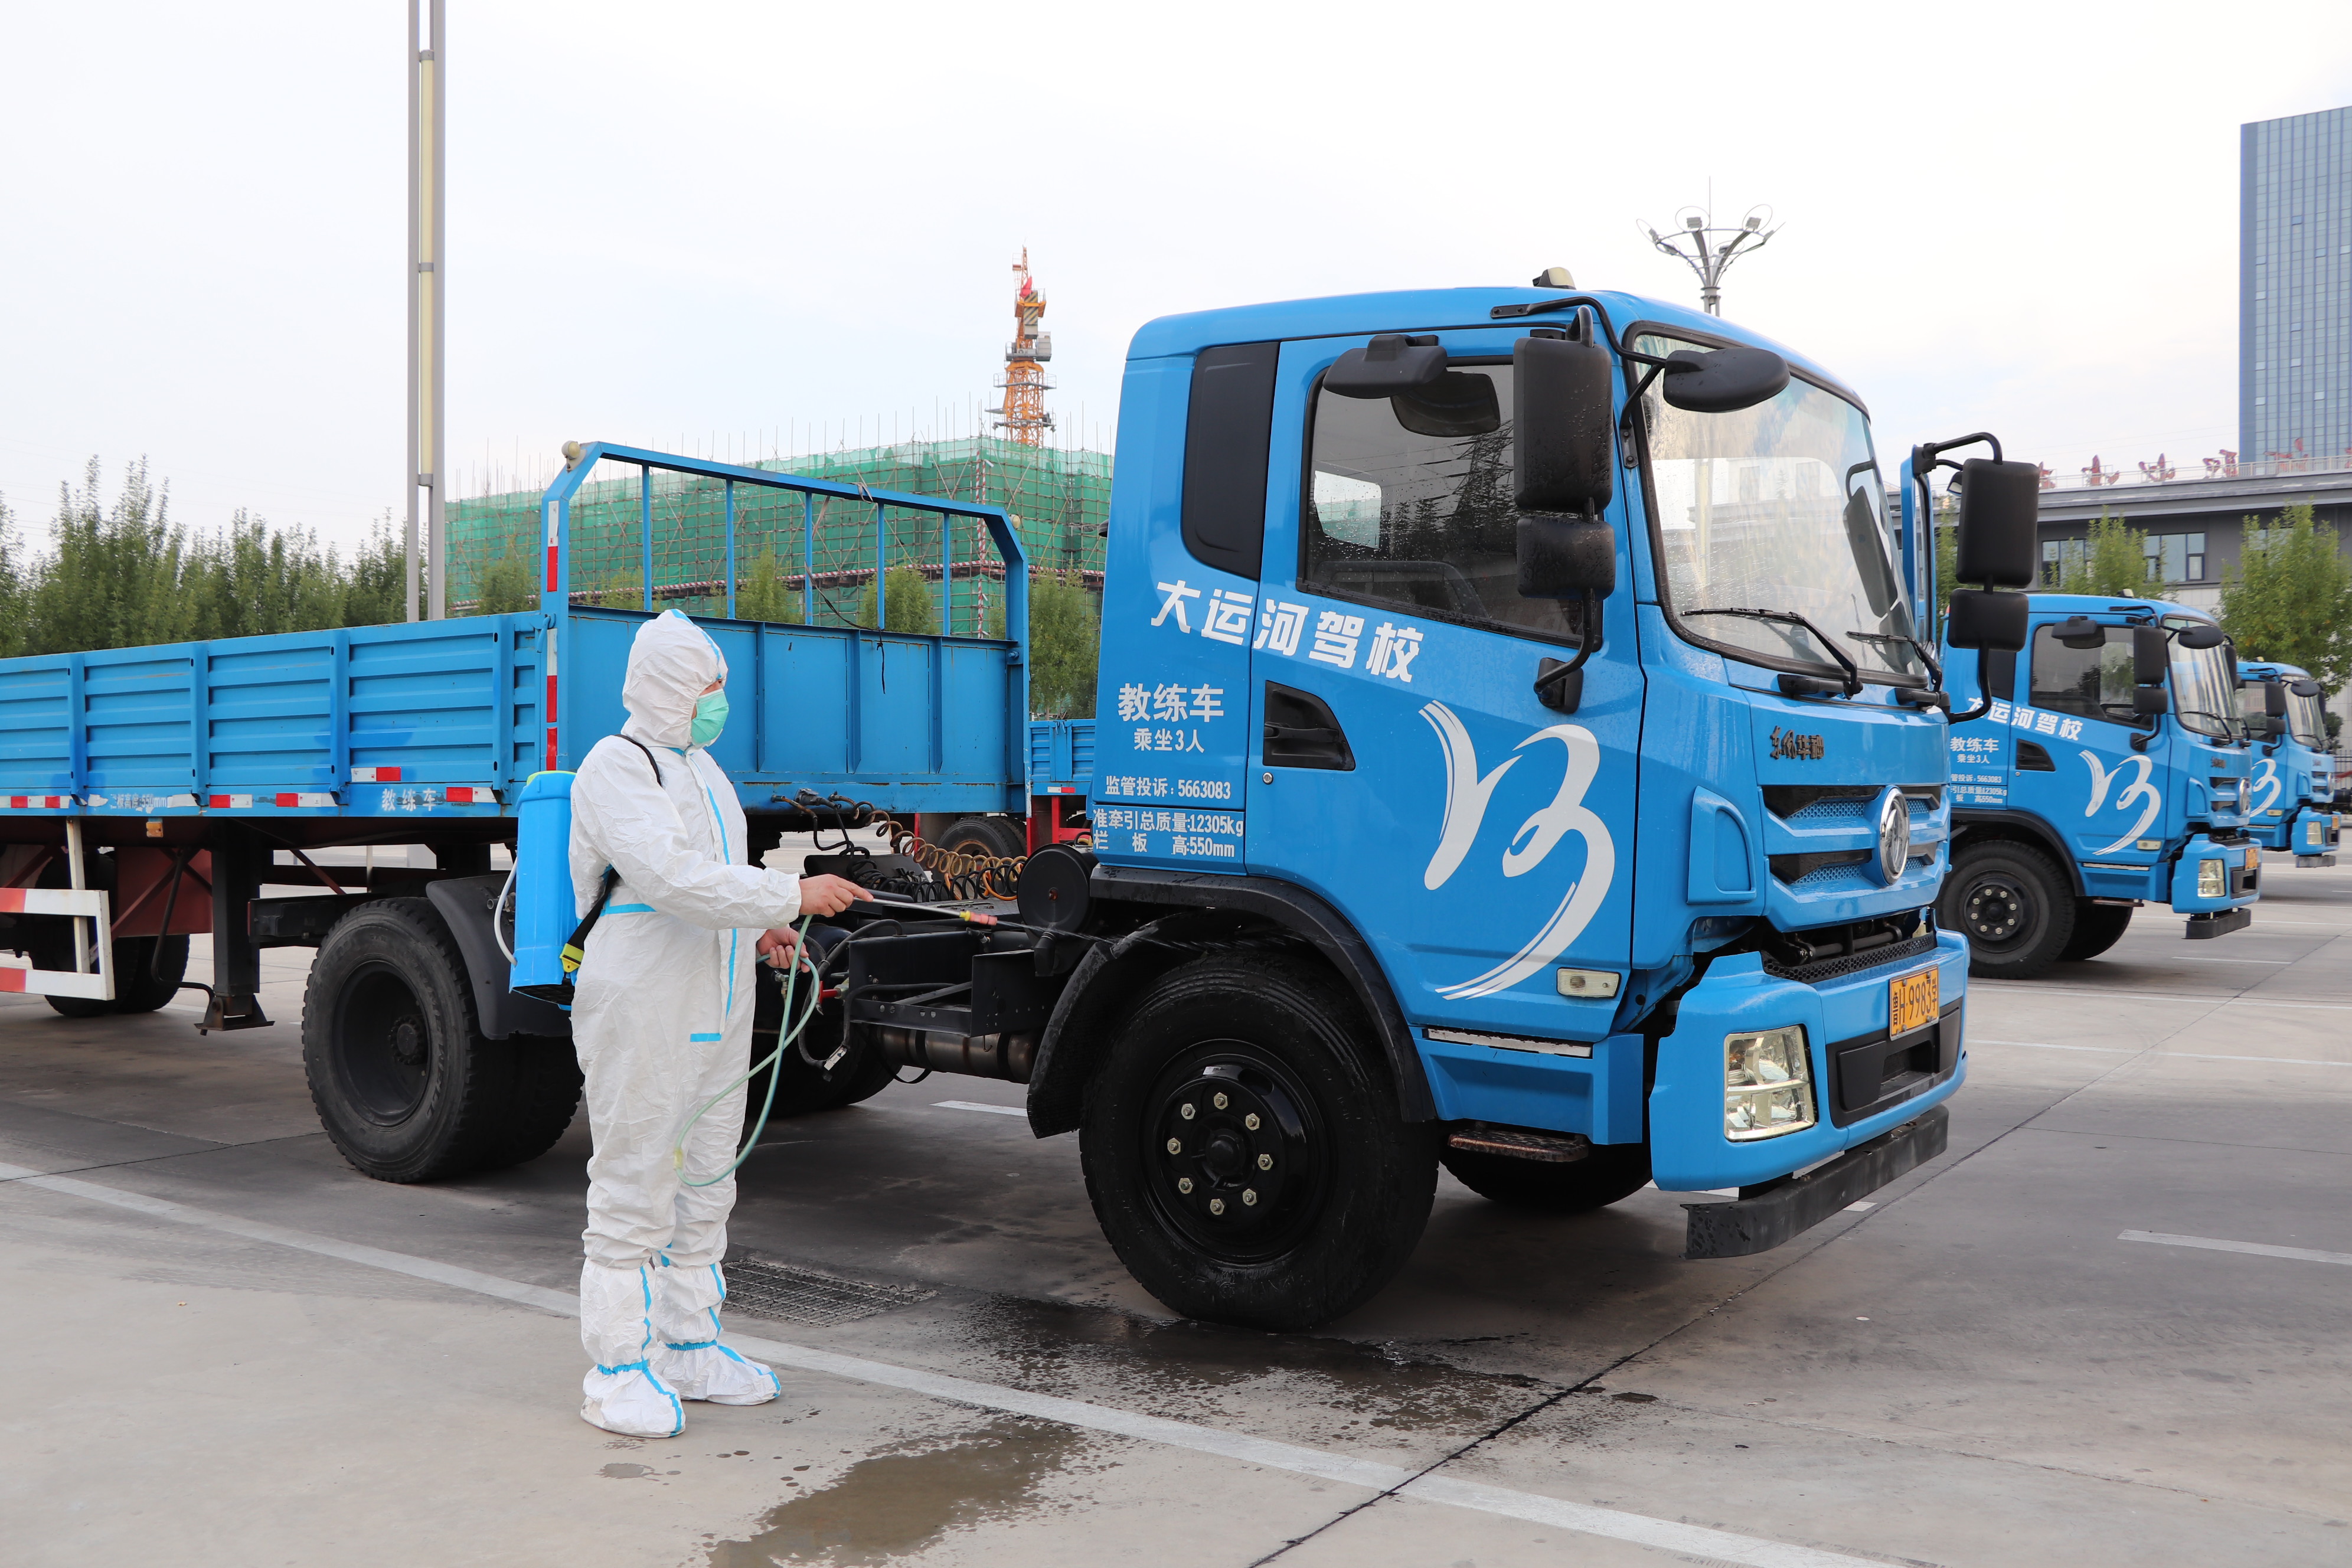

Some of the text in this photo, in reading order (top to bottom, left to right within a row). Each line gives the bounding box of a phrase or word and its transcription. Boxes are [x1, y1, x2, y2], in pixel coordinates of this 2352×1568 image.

[1151, 580, 1423, 682] 大运河驾校
[1118, 682, 1224, 723] 教练车
[1133, 727, 1205, 753] 乘坐3人
[1950, 736, 1999, 753] 教练车
[1956, 753, 1990, 764] 乘坐3人
[381, 788, 436, 811] 教练车
[1093, 829, 1109, 851] 栏
[1132, 832, 1147, 852] 板
